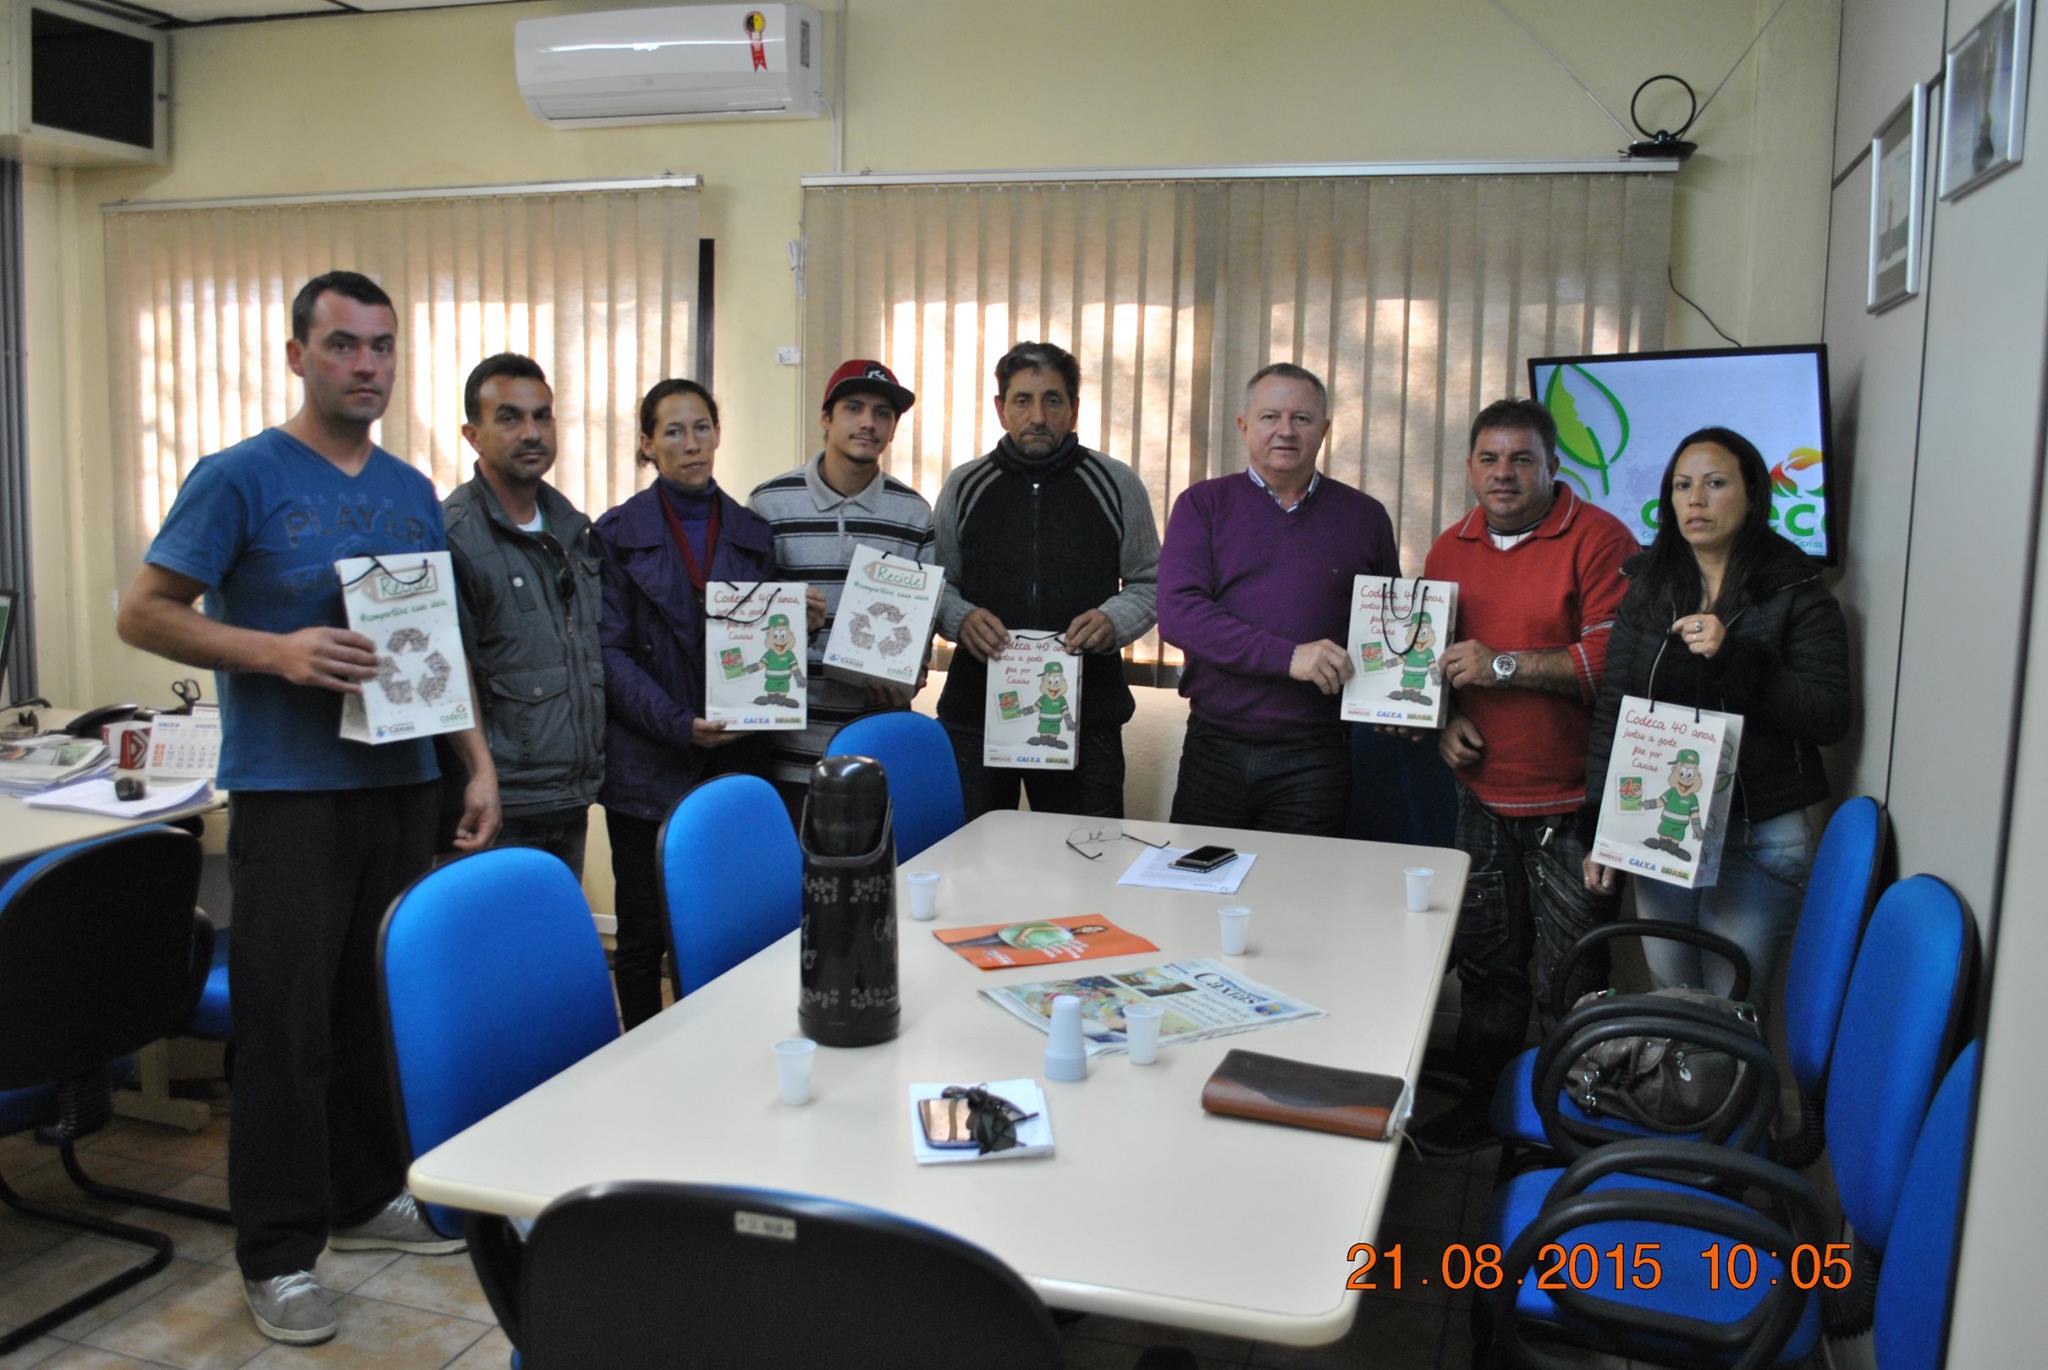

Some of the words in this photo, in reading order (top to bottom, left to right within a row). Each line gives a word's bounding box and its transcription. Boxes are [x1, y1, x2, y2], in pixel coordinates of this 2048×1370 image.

[879, 566, 921, 586] Recicle
[1036, 642, 1049, 652] 40
[1626, 710, 1665, 730] Codeca
[1672, 721, 1688, 735] 40
[1691, 729, 1717, 743] anos,
[1632, 758, 1657, 772] Caxias
[1629, 858, 1656, 871] CAIXA
